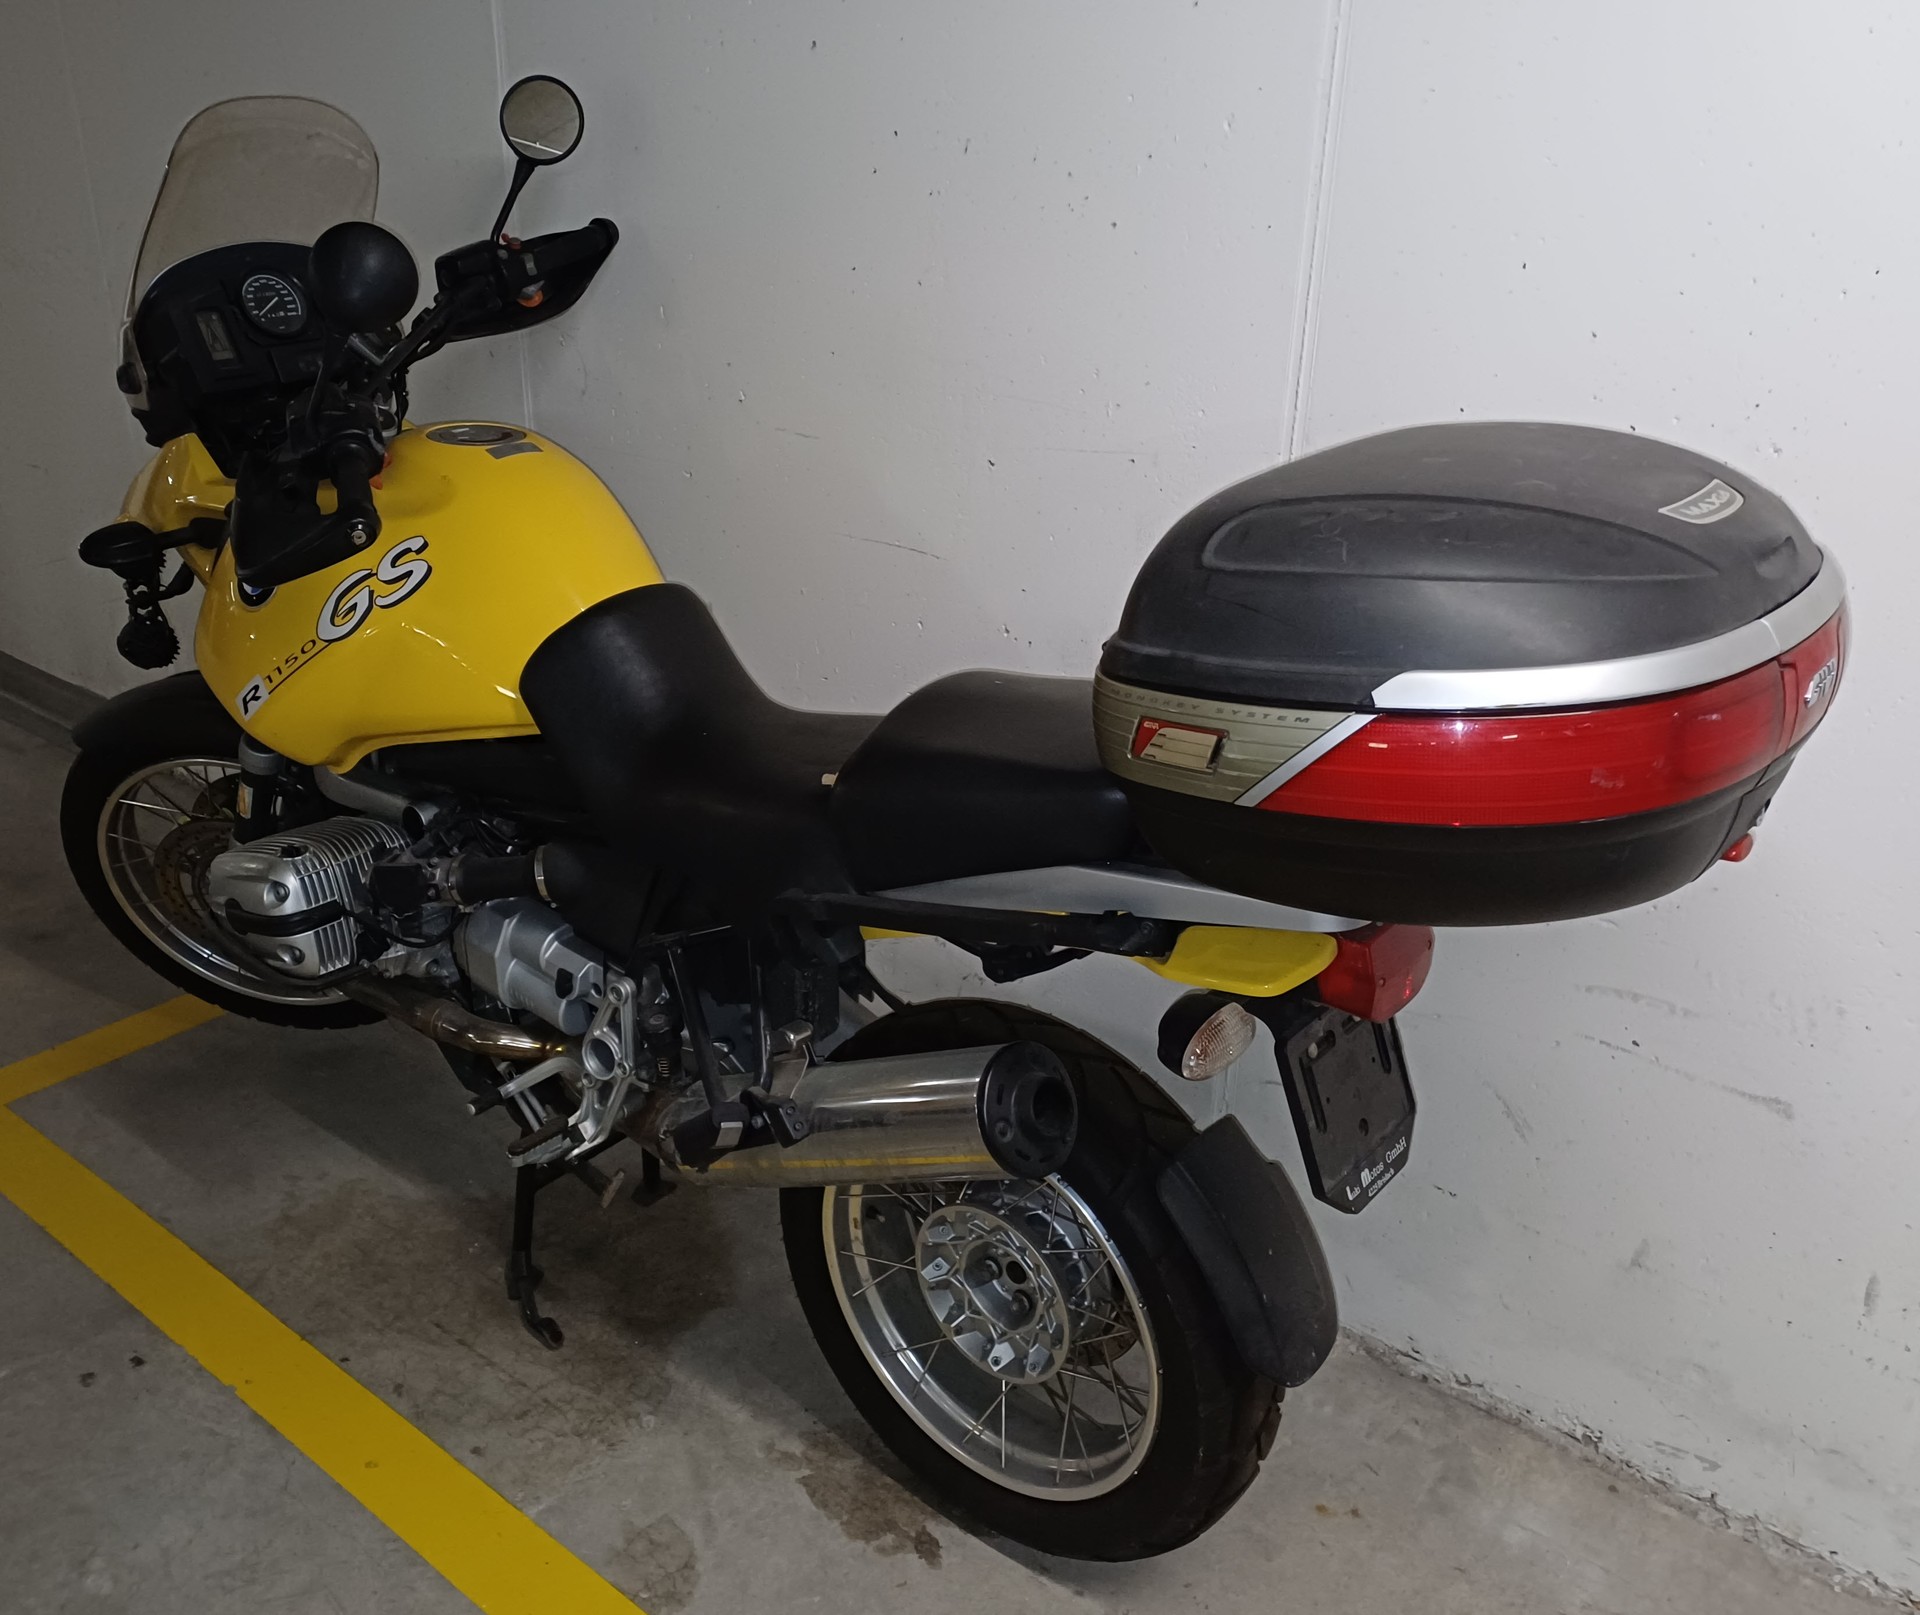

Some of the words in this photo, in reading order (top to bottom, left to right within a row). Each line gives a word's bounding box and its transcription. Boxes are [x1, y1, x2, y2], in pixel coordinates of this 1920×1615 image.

[241, 684, 262, 715] R
[264, 639, 316, 685] 1150
[316, 535, 433, 643] GS
[1111, 688, 1201, 709] MONOKEY
[1215, 707, 1311, 723] SYSTEM
[1361, 1162, 1384, 1188] Motos
[1386, 1136, 1407, 1163] GmbH
